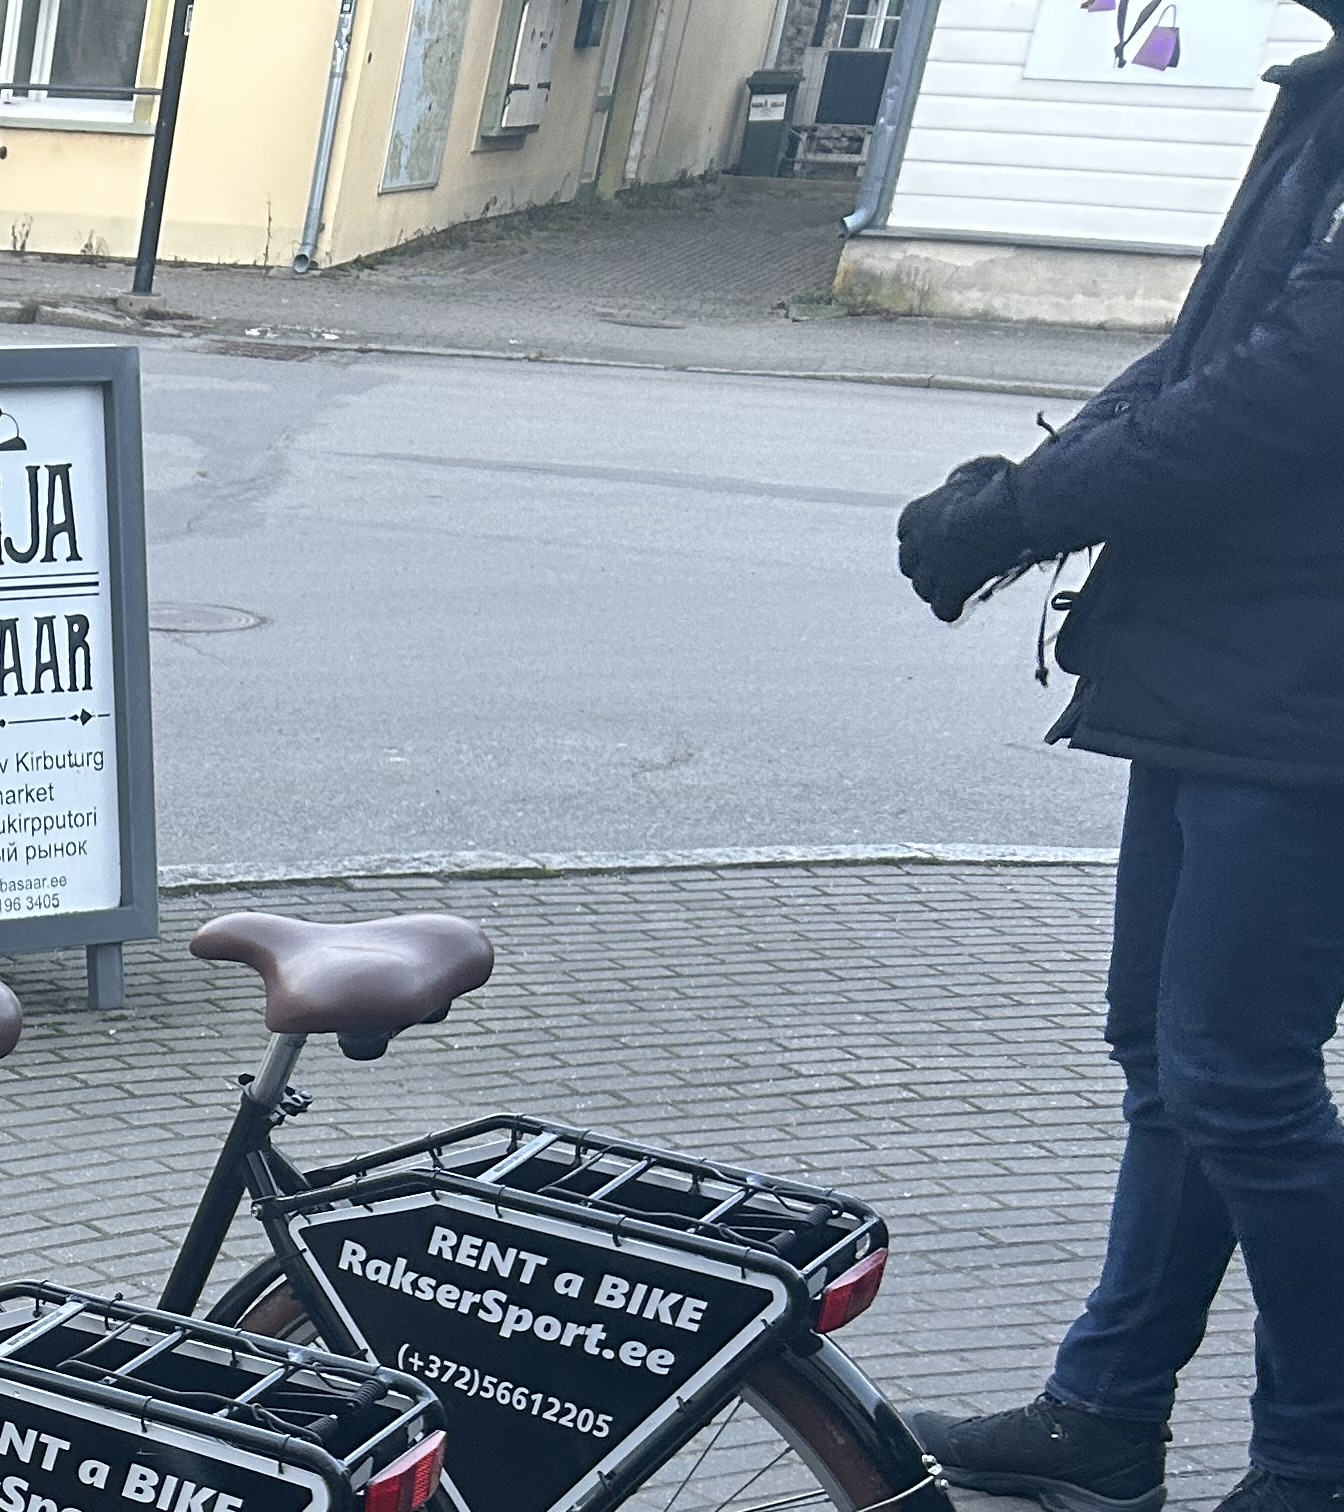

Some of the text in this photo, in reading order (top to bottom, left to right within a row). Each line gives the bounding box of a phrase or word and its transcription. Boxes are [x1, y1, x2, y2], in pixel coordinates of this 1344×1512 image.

[15, 750, 105, 773] Kirbuturg
[25, 839, 88, 864] рынок
[26, 893, 60, 911] 3405
[427, 1225, 708, 1333] RENT a BIKE
[338, 1240, 676, 1376] RakserSport.ee
[397, 1343, 613, 1439] (+372)56612205
[78, 1457, 111, 1489] a
